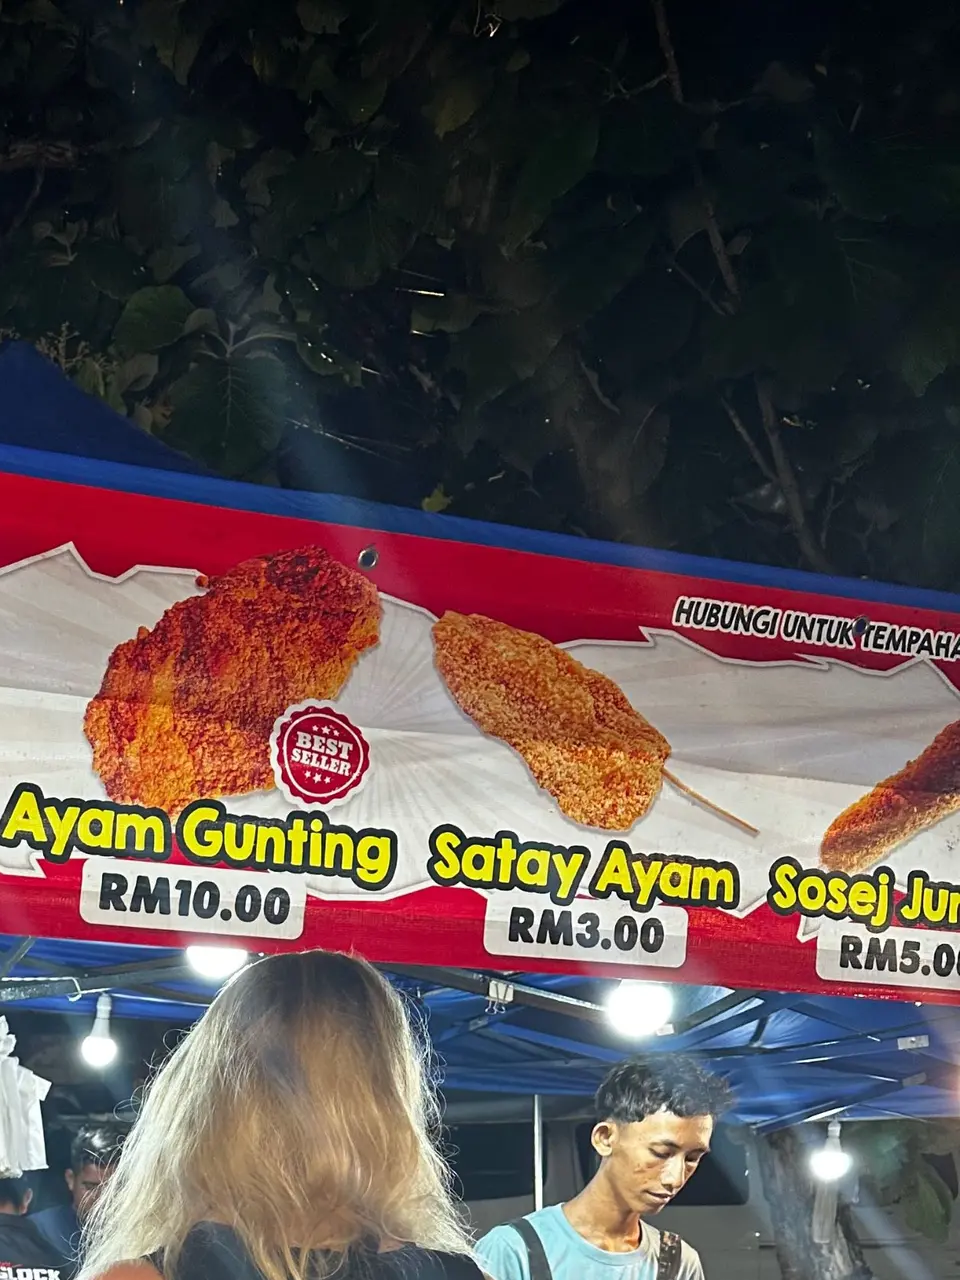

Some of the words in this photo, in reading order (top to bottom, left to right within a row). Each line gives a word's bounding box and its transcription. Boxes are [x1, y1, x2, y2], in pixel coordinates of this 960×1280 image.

[675, 598, 779, 637] HUBUNGI
[783, 615, 855, 648] UNTUK
[290, 746, 353, 777] SELLER
[295, 729, 354, 760] BEST
[0, 789, 166, 857] Ayam
[181, 806, 392, 883] Gunting
[433, 830, 586, 899] Satay
[595, 846, 735, 906] Ayam
[97, 871, 292, 926] RM10.00
[772, 863, 890, 927] Sosej
[507, 906, 666, 954] RM3.00
[839, 934, 960, 978] RM5.0
